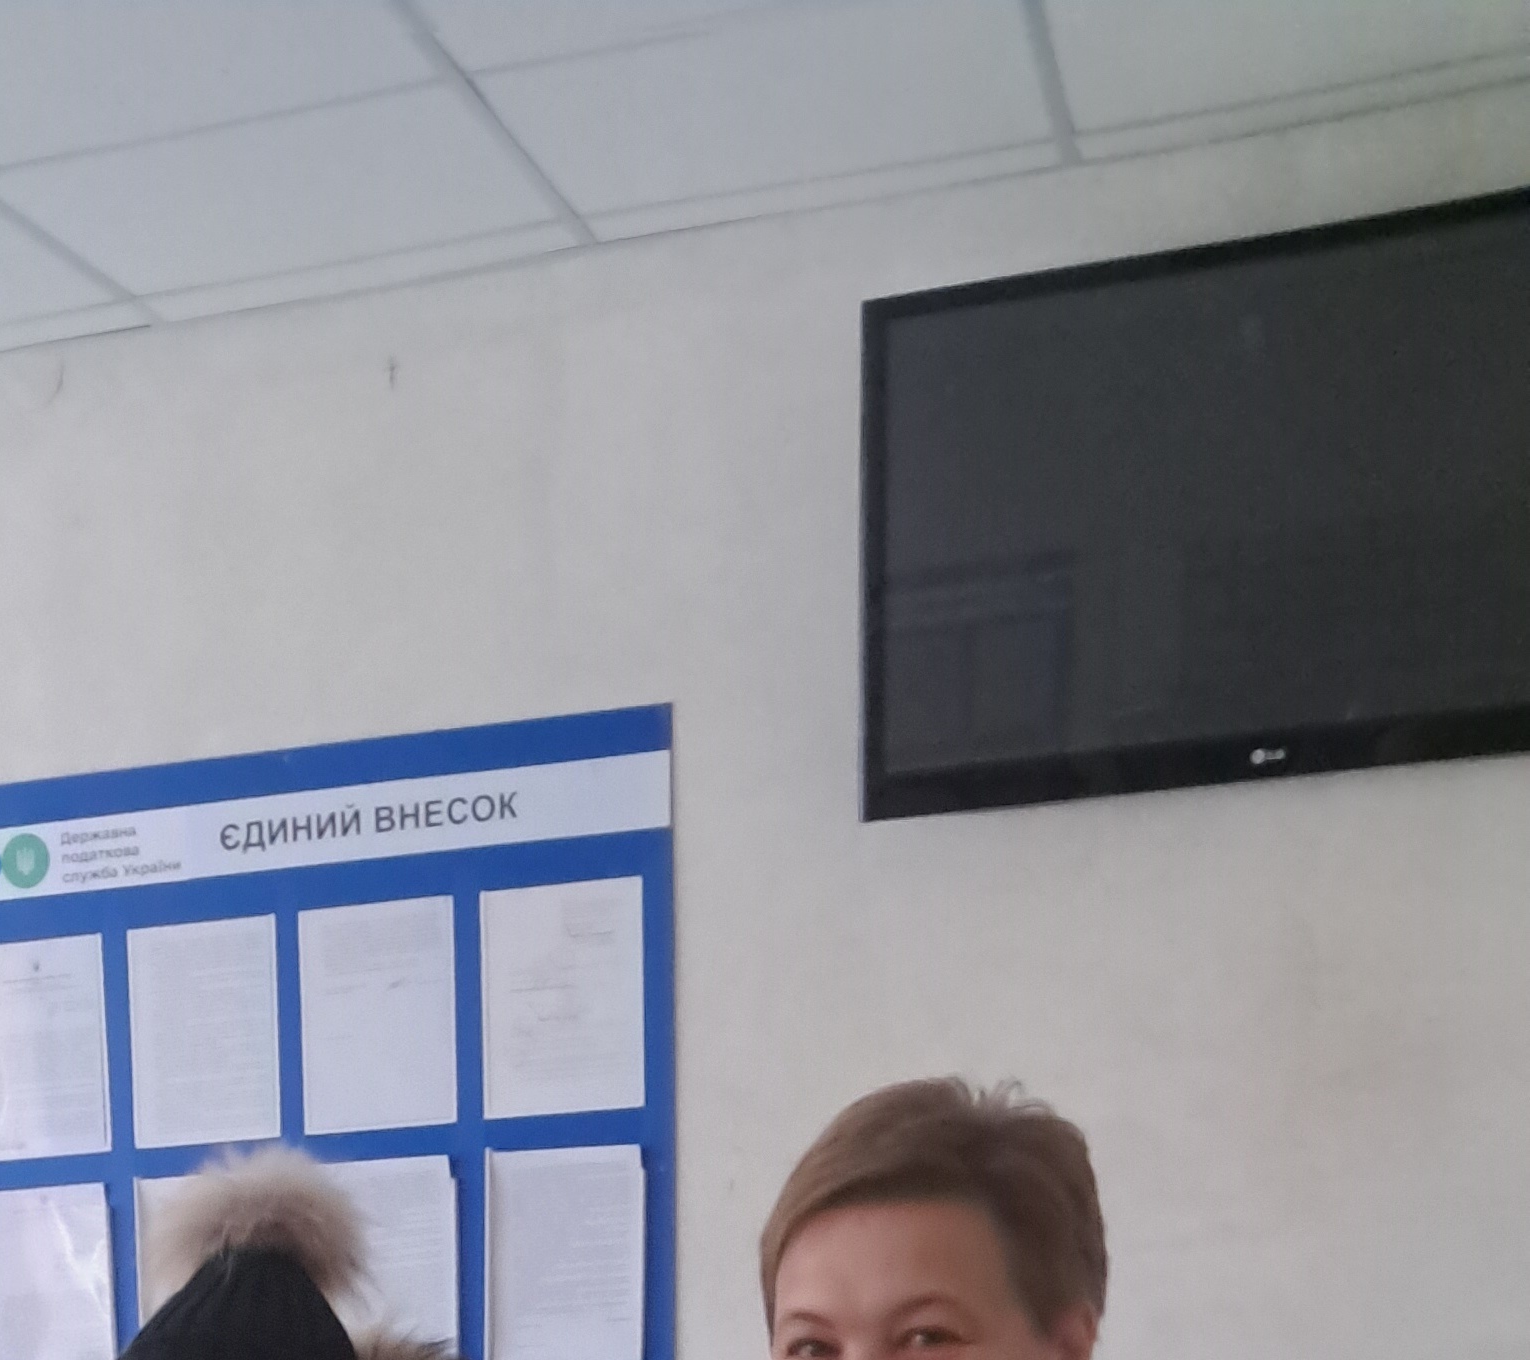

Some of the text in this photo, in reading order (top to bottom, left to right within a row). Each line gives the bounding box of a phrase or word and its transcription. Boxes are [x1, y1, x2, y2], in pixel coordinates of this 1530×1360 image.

[220, 792, 517, 853] ЄДИНИЙ ВНЕСОК
[61, 826, 137, 845] Державна
[62, 846, 140, 863] податкова
[63, 860, 182, 883] служба України
